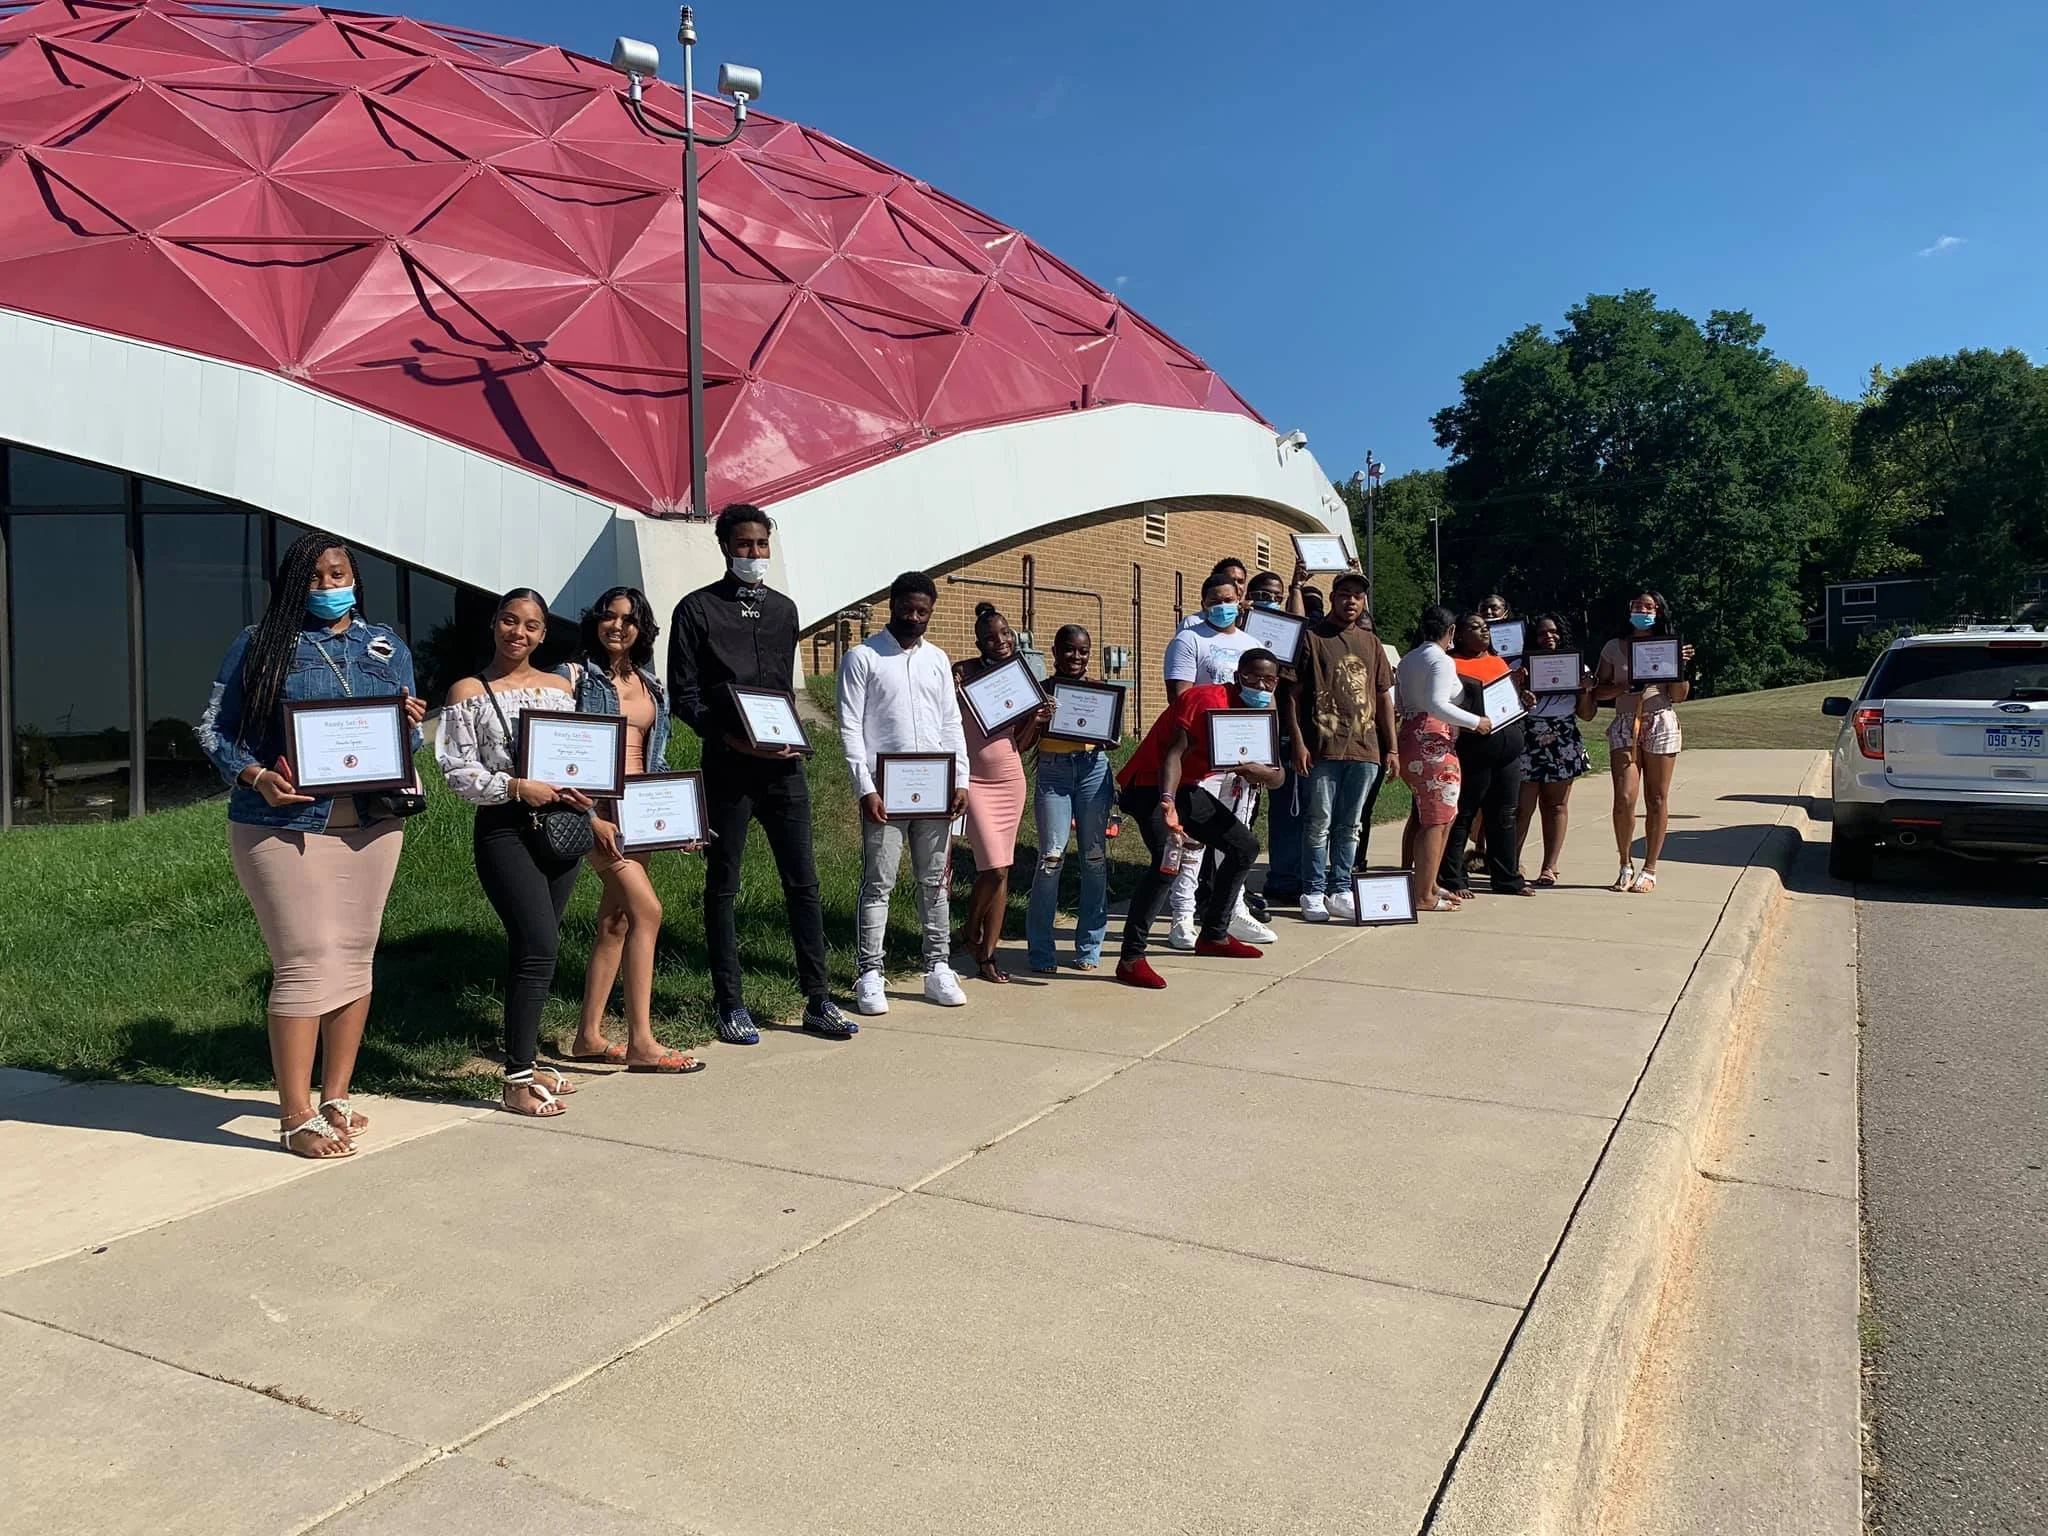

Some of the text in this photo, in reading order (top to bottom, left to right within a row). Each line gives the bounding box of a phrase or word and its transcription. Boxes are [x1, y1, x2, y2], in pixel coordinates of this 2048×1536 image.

[741, 609, 760, 618] KYO
[1988, 734, 2007, 746] 098
[2020, 735, 2040, 747] 575
